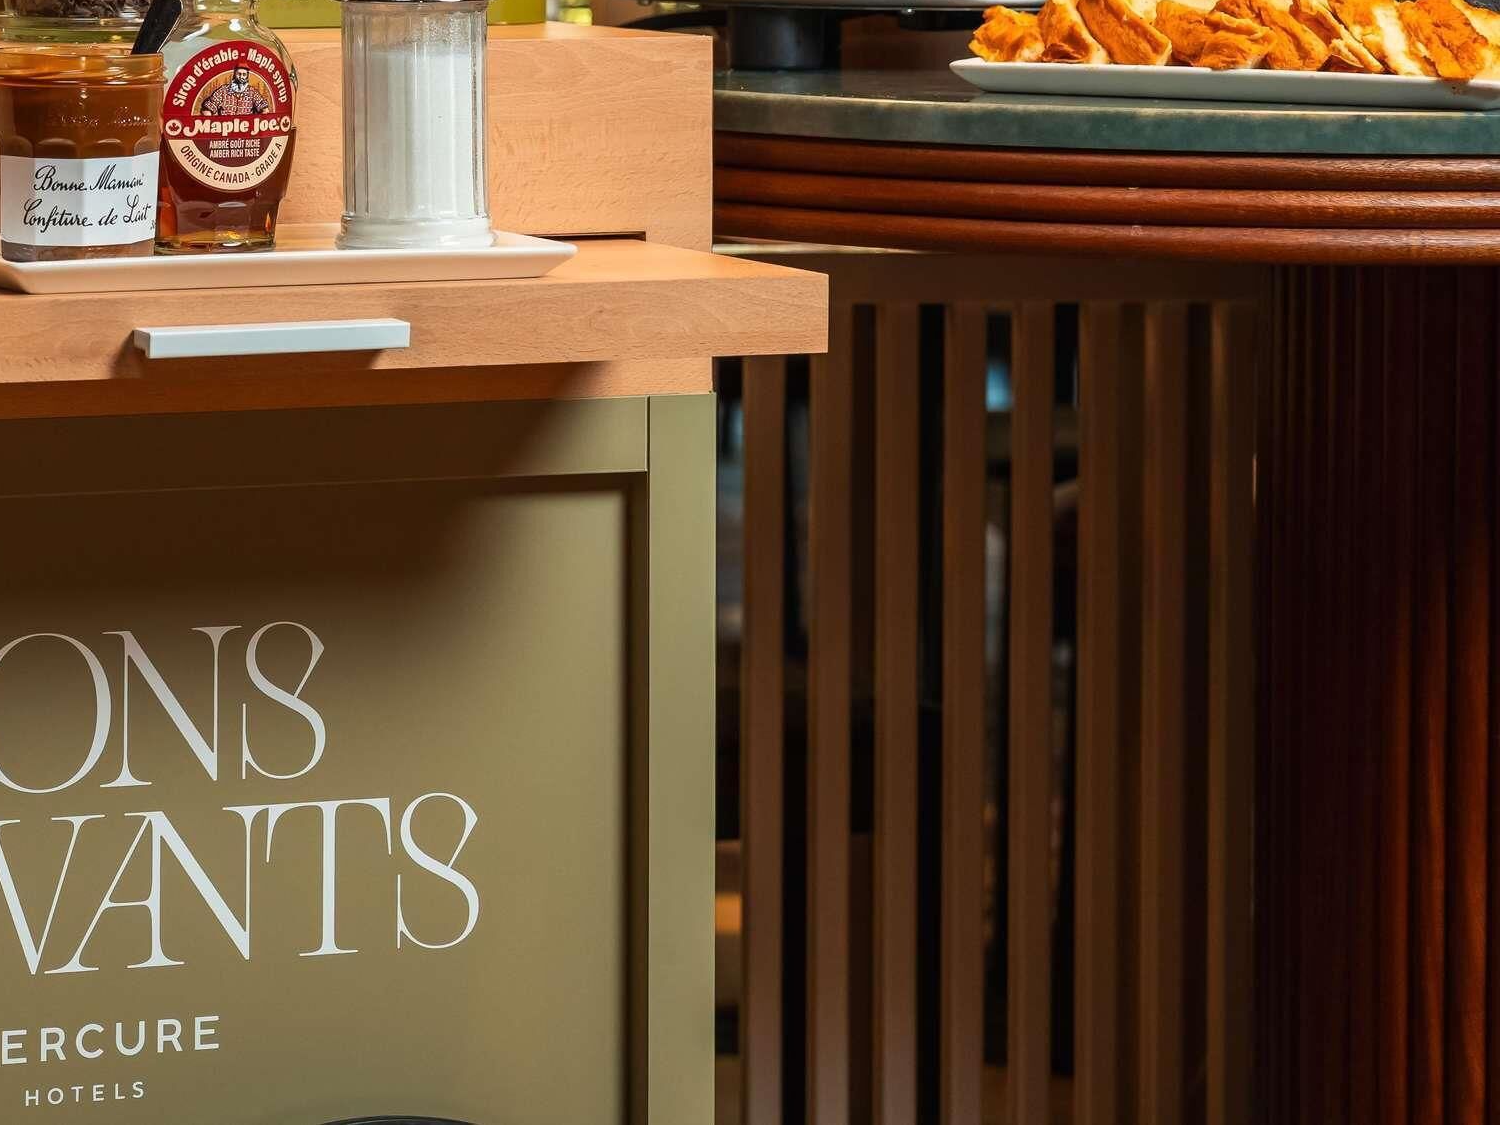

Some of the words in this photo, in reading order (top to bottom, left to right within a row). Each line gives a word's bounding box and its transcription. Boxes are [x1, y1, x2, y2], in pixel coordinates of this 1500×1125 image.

[172, 75, 197, 107] Sirop
[193, 47, 239, 78] d'érable
[247, 48, 276, 73] Maple
[273, 71, 288, 104] syrup
[183, 118, 250, 137] Maple
[180, 145, 214, 178] ORIGINE
[213, 170, 251, 184] CANADA
[255, 150, 278, 177] GRADE
[209, 148, 230, 158] AMBER
[230, 148, 244, 157] RICH
[244, 147, 260, 157] TASTE
[33, 164, 88, 191] Bonne
[89, 163, 144, 190] Maman
[23, 198, 93, 233] Confiture
[98, 208, 118, 226] de
[122, 194, 152, 223] Lait
[24, 1081, 146, 1107] HOTELS
